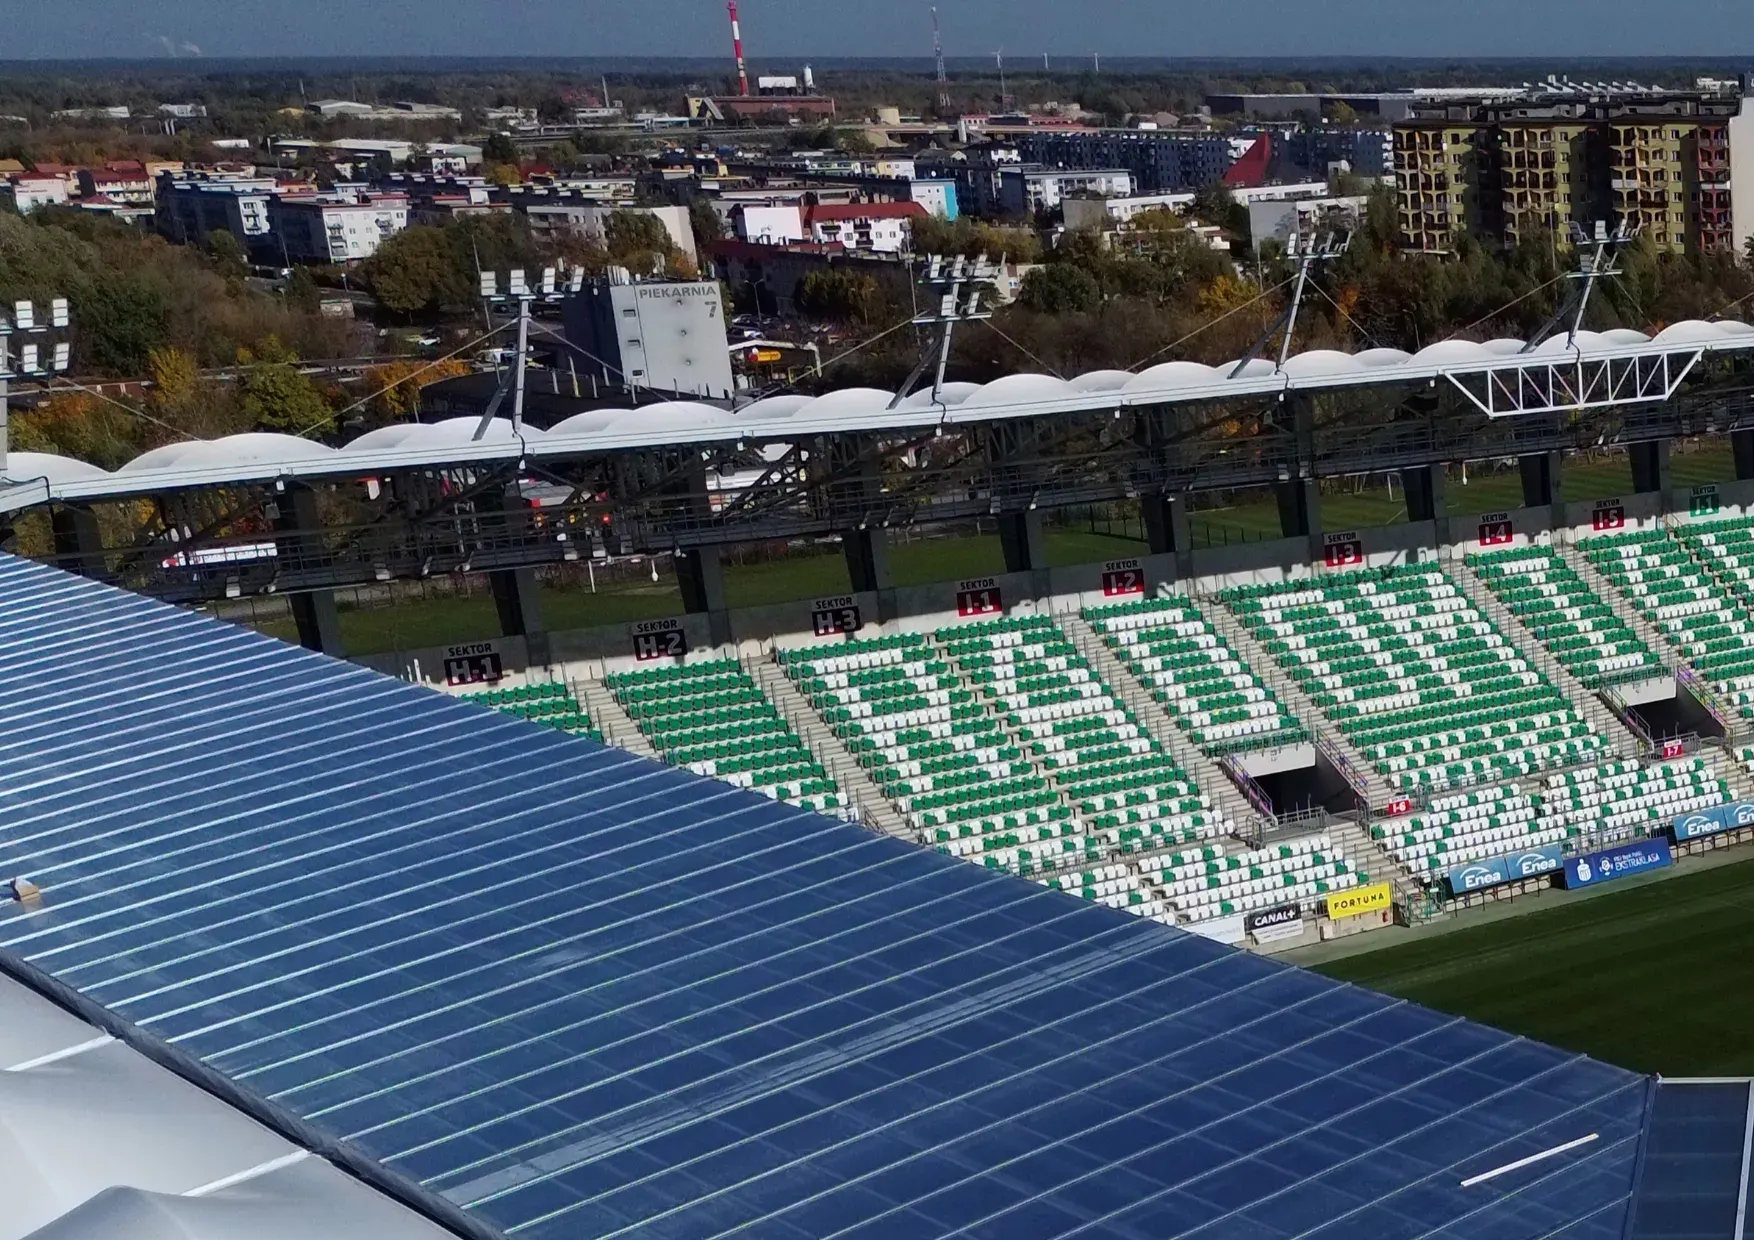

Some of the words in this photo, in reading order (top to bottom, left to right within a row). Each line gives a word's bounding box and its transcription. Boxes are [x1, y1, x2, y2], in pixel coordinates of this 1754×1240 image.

[640, 286, 717, 298] PIEKARNIA
[704, 301, 717, 318] 7
[1482, 513, 1508, 523] SEKTOR
[1599, 509, 1621, 528] I-5
[1328, 532, 1357, 543] SEKTOR
[1485, 524, 1507, 544] I-4
[1333, 544, 1356, 565] I-3
[1106, 560, 1138, 571] SEKTOR
[960, 579, 995, 591] SEKTOR
[1111, 572, 1138, 593] I-2
[816, 597, 853, 610] SEKTOR
[966, 592, 994, 614] I-1
[636, 620, 678, 632] SEKTOR
[817, 610, 856, 634] H-3
[448, 643, 492, 657] SEKTOR
[638, 632, 683, 658] H-2
[450, 657, 498, 684] H-1
[1667, 745, 1679, 757] I-7
[1688, 820, 1720, 836] Enea
[1522, 858, 1556, 875] Enea
[1614, 852, 1660, 871] EKSTRAKLASA
[1465, 872, 1500, 888] Enea
[1334, 892, 1384, 910] FORTUNA
[1254, 909, 1296, 926] CANAL+
